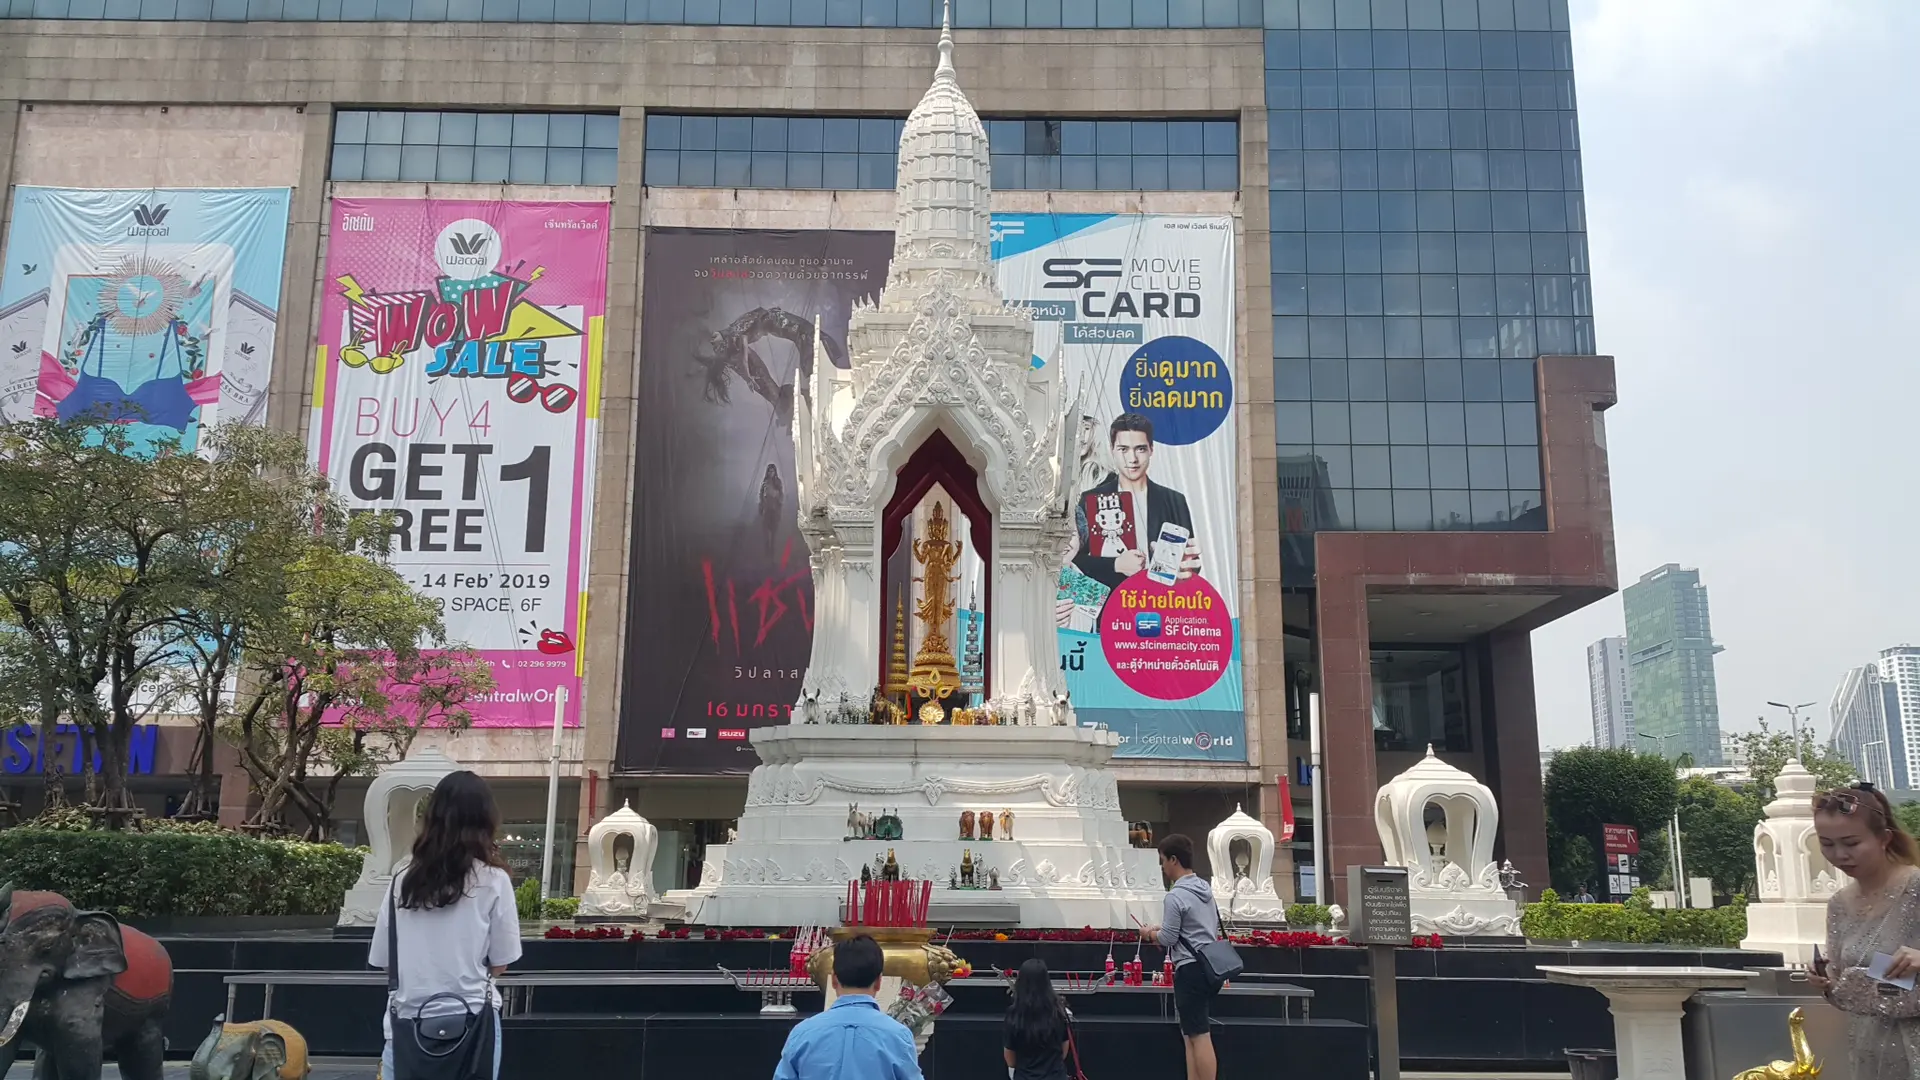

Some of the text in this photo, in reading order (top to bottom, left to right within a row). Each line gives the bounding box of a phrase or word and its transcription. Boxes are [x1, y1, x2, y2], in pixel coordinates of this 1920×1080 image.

[127, 226, 170, 237] Wacoal
[445, 254, 488, 266] Wacoal
[1042, 258, 1201, 289] SF MOVIE
[1131, 275, 1202, 291] CLUB
[1083, 291, 1201, 318] CARD
[373, 280, 516, 358] WOW
[1073, 324, 1135, 339] ได้ส่วนลด
[425, 340, 543, 377] SALE
[1135, 353, 1217, 386] ยิ่งดูมาก
[1129, 382, 1224, 409] ยิ่งลดมาก
[355, 396, 491, 437] BUY 4
[349, 442, 551, 553] GET 1
[422, 573, 447, 588] 14
[499, 573, 550, 589] 2019
[451, 597, 514, 614] SPACE,
[520, 597, 542, 612] 6F
[1120, 589, 1212, 610] ใช้ง่ายโดนใจ
[1111, 618, 1132, 631] ผ่าน
[1165, 625, 1222, 637] SF Cinema
[1114, 640, 1220, 653] www.sfcinemacity.com
[517, 660, 567, 668] 02 296 9979
[734, 665, 799, 679] วิปลาส
[1116, 656, 1220, 673] และตู้จำหน่ายตั๋วอัตโนมัติ
[707, 700, 728, 717] 16
